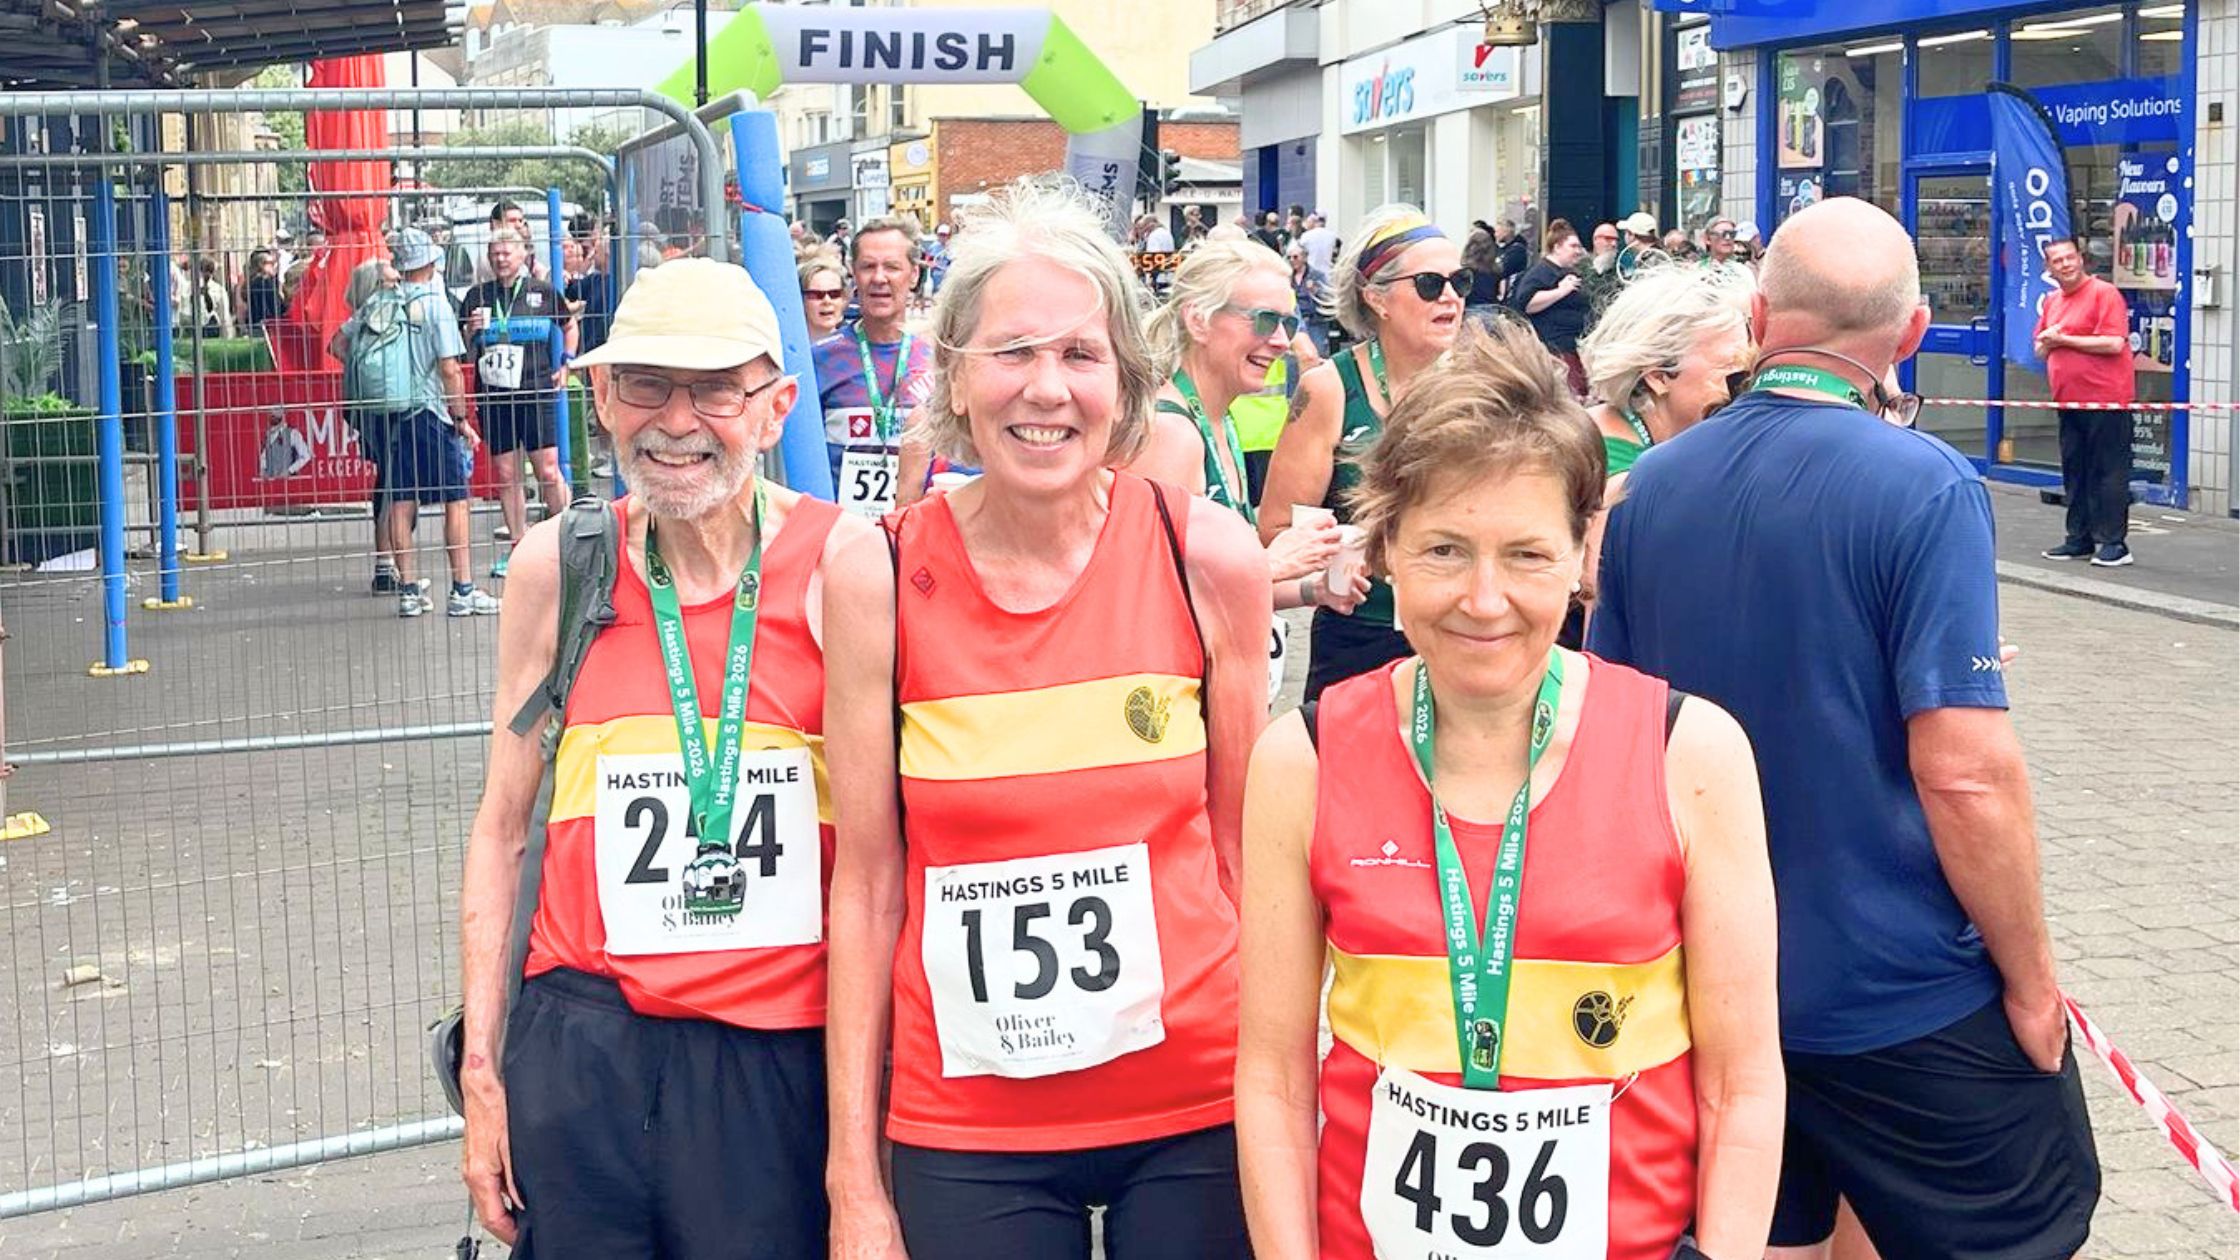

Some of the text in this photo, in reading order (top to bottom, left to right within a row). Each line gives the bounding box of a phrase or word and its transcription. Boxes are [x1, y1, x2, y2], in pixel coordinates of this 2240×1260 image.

[798, 29, 1015, 70] FINISH
[1354, 57, 1415, 124] savers
[1463, 70, 1507, 82] savers
[2056, 104, 2107, 126] Vaping
[2110, 98, 2181, 118] Solutions
[2119, 160, 2143, 176] New
[2119, 177, 2166, 198] flavours
[485, 353, 515, 369] 415
[1763, 369, 1819, 386] Hastings
[853, 469, 898, 501] 52
[663, 620, 706, 778] Hastings 5 Mile 2026
[715, 644, 748, 806] Hastings 5 Mile 2026
[1415, 704, 1429, 744] 2026
[607, 772, 689, 790] HASTIN
[747, 766, 799, 784] MILE
[623, 793, 784, 885] 24
[1500, 832, 1520, 871] Mile
[941, 864, 1129, 902] HASTINGS 5 MILE
[1499, 876, 1513, 888] 5
[961, 896, 1121, 1003] 153
[1447, 867, 1479, 1014] Hastings 5 Mile
[1487, 895, 1512, 975] Hastings
[996, 1014, 1056, 1032] Oliver
[1000, 1029, 1076, 1054] & Bailey
[1388, 1082, 1591, 1133] HASTINGS 5 MILE
[1394, 1129, 1568, 1247] 436
